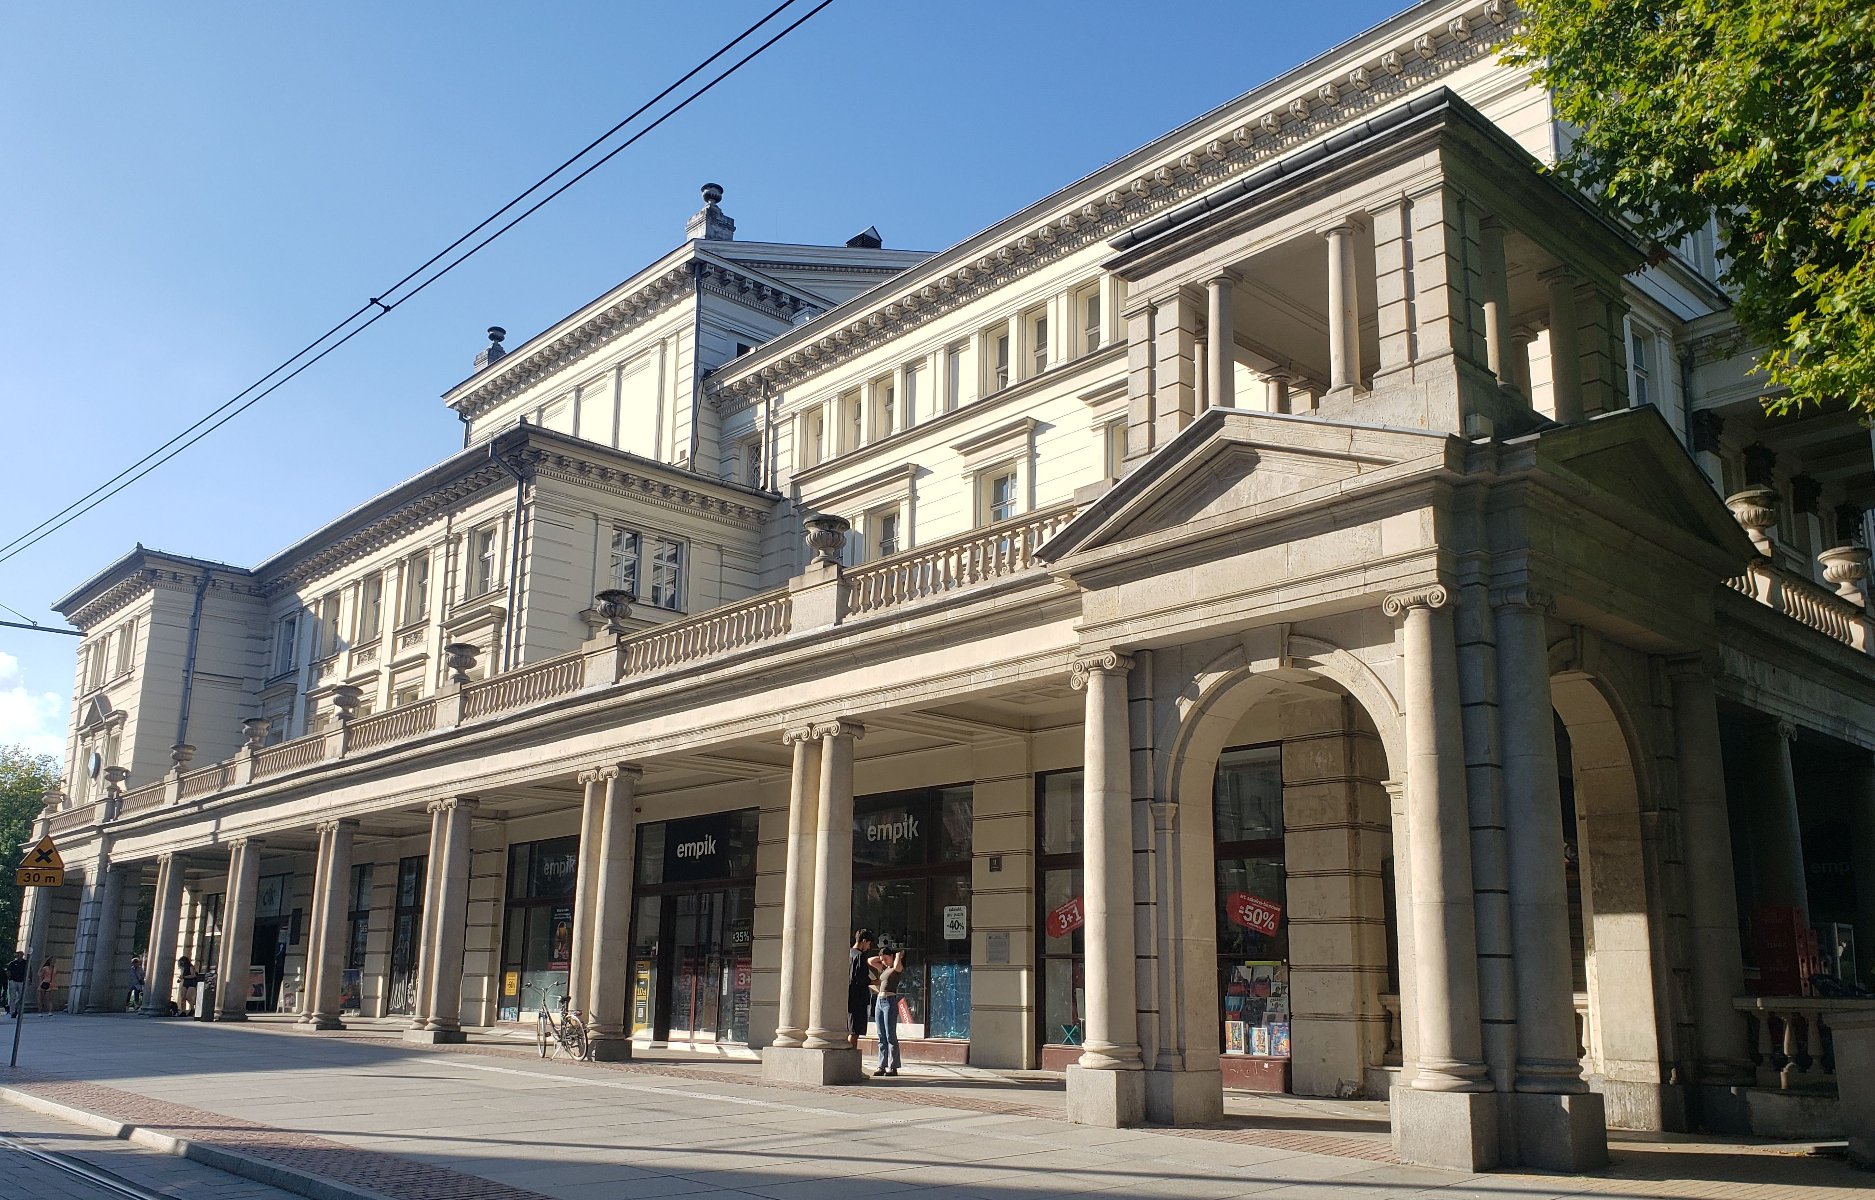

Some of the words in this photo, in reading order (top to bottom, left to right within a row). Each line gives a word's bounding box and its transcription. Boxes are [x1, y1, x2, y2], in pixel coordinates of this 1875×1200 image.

[868, 813, 919, 844] empik
[677, 834, 717, 859] empik
[23, 872, 40, 883] 30
[45, 875, 56, 883] m
[544, 855, 576, 878] empik
[946, 920, 964, 931] -40%
[1058, 905, 1082, 929] 3+1
